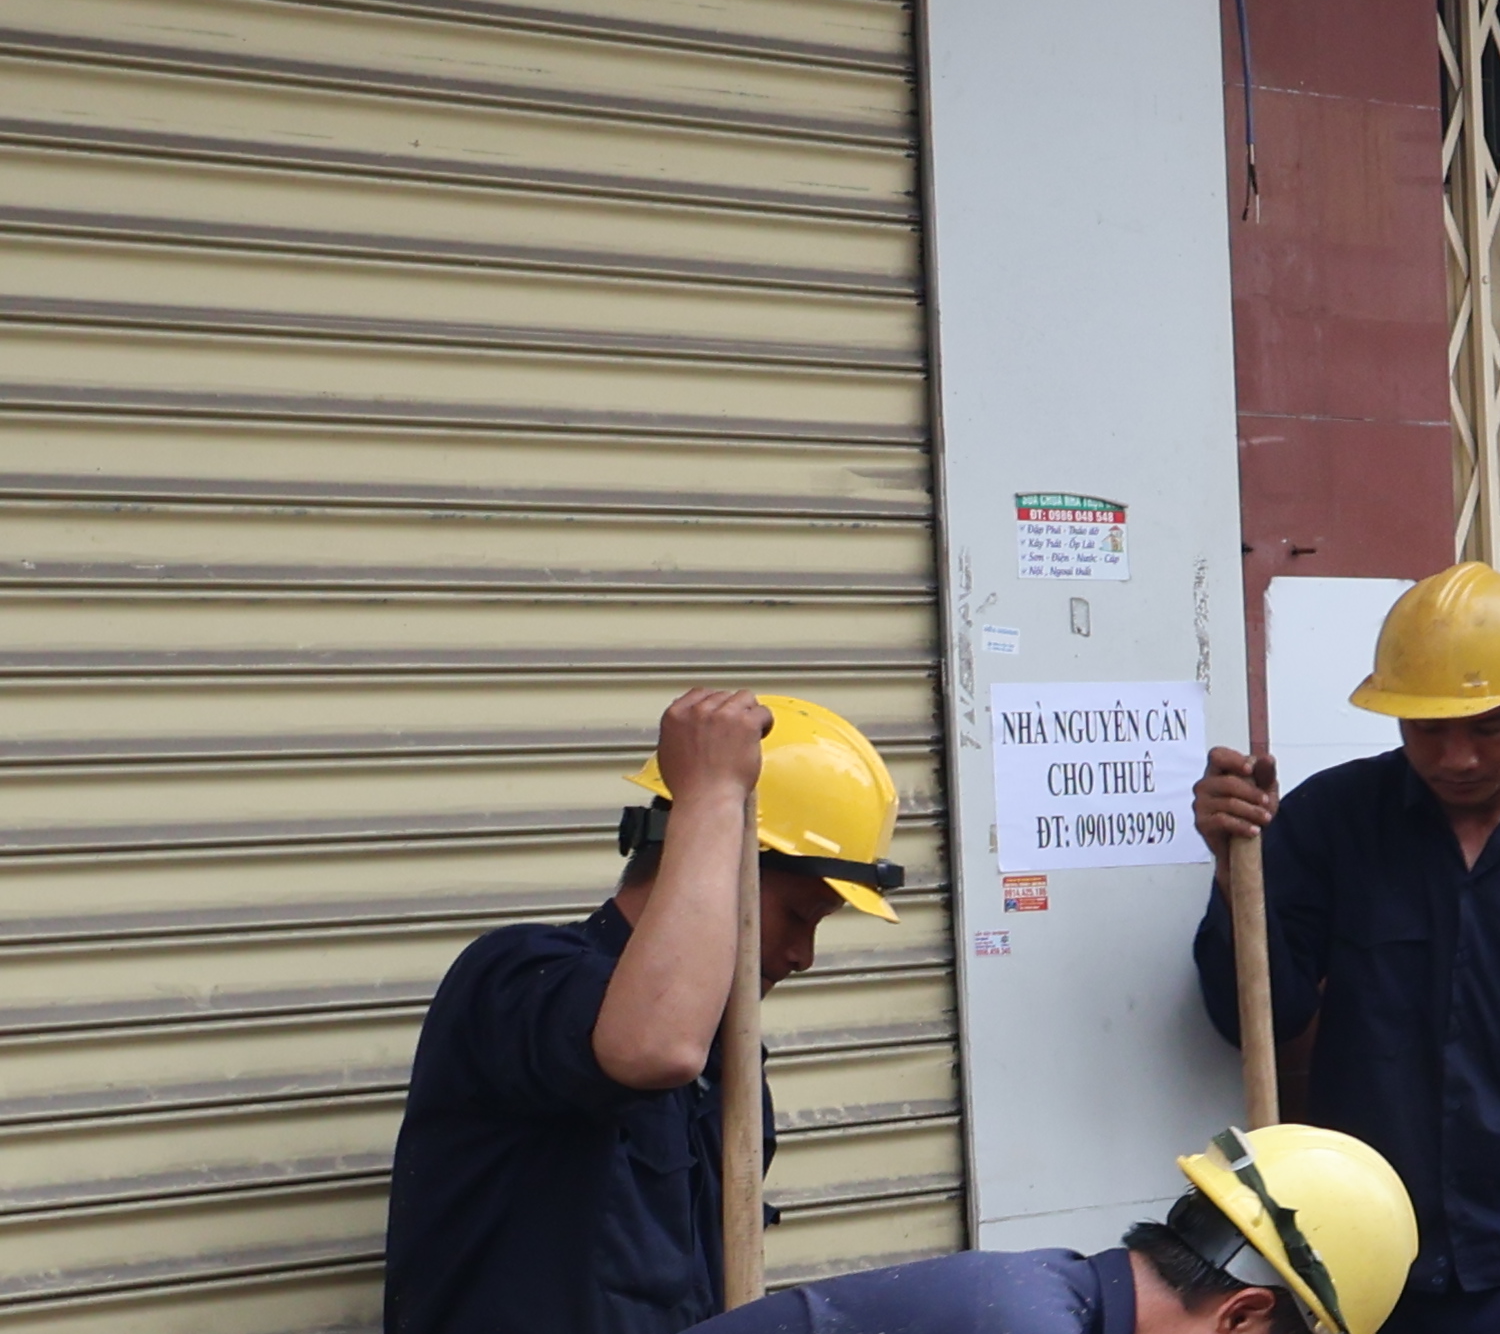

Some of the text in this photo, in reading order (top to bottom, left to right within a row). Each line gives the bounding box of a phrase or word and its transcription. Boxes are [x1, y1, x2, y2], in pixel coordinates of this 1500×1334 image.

[1075, 511, 1094, 522] 048
[1096, 512, 1114, 523] 548
[1001, 700, 1188, 745] NHÀ NGUYÊN CĂN
[1047, 751, 1155, 796] CHO THUÊ
[1036, 811, 1175, 849] ĐT: 0901939299
